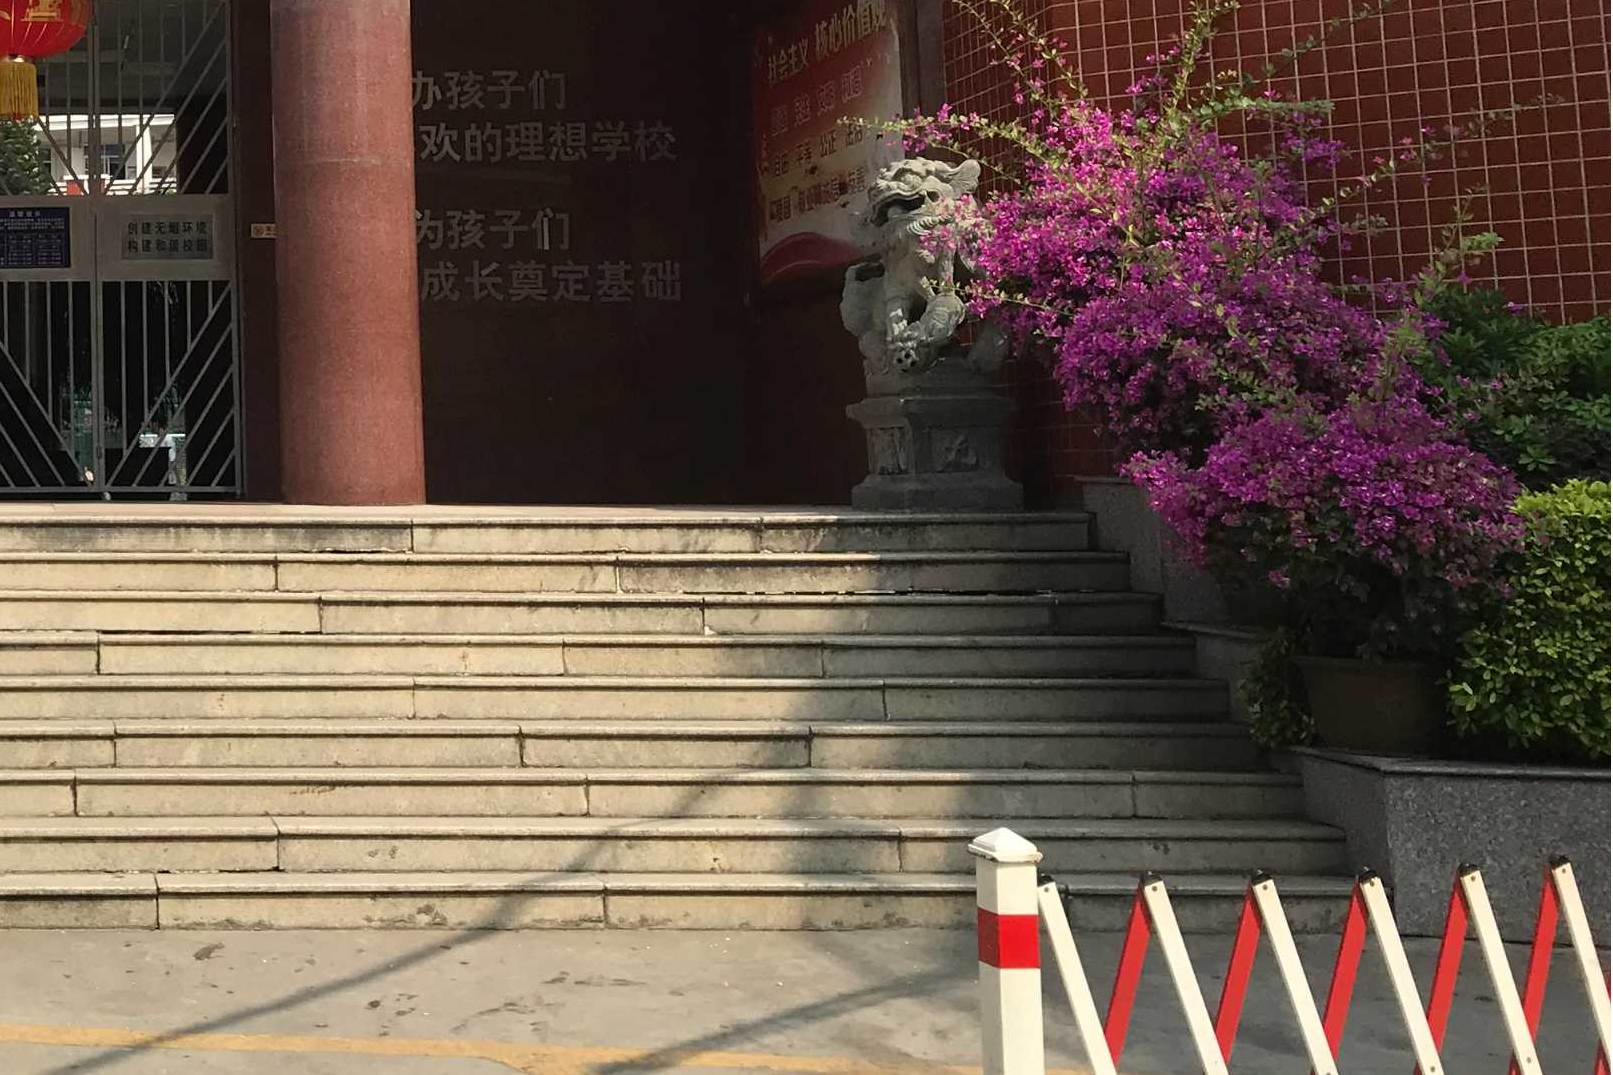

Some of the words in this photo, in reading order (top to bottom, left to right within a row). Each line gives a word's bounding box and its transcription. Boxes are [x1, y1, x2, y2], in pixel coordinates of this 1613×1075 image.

[421, 260, 682, 303] 成长奠定基础
